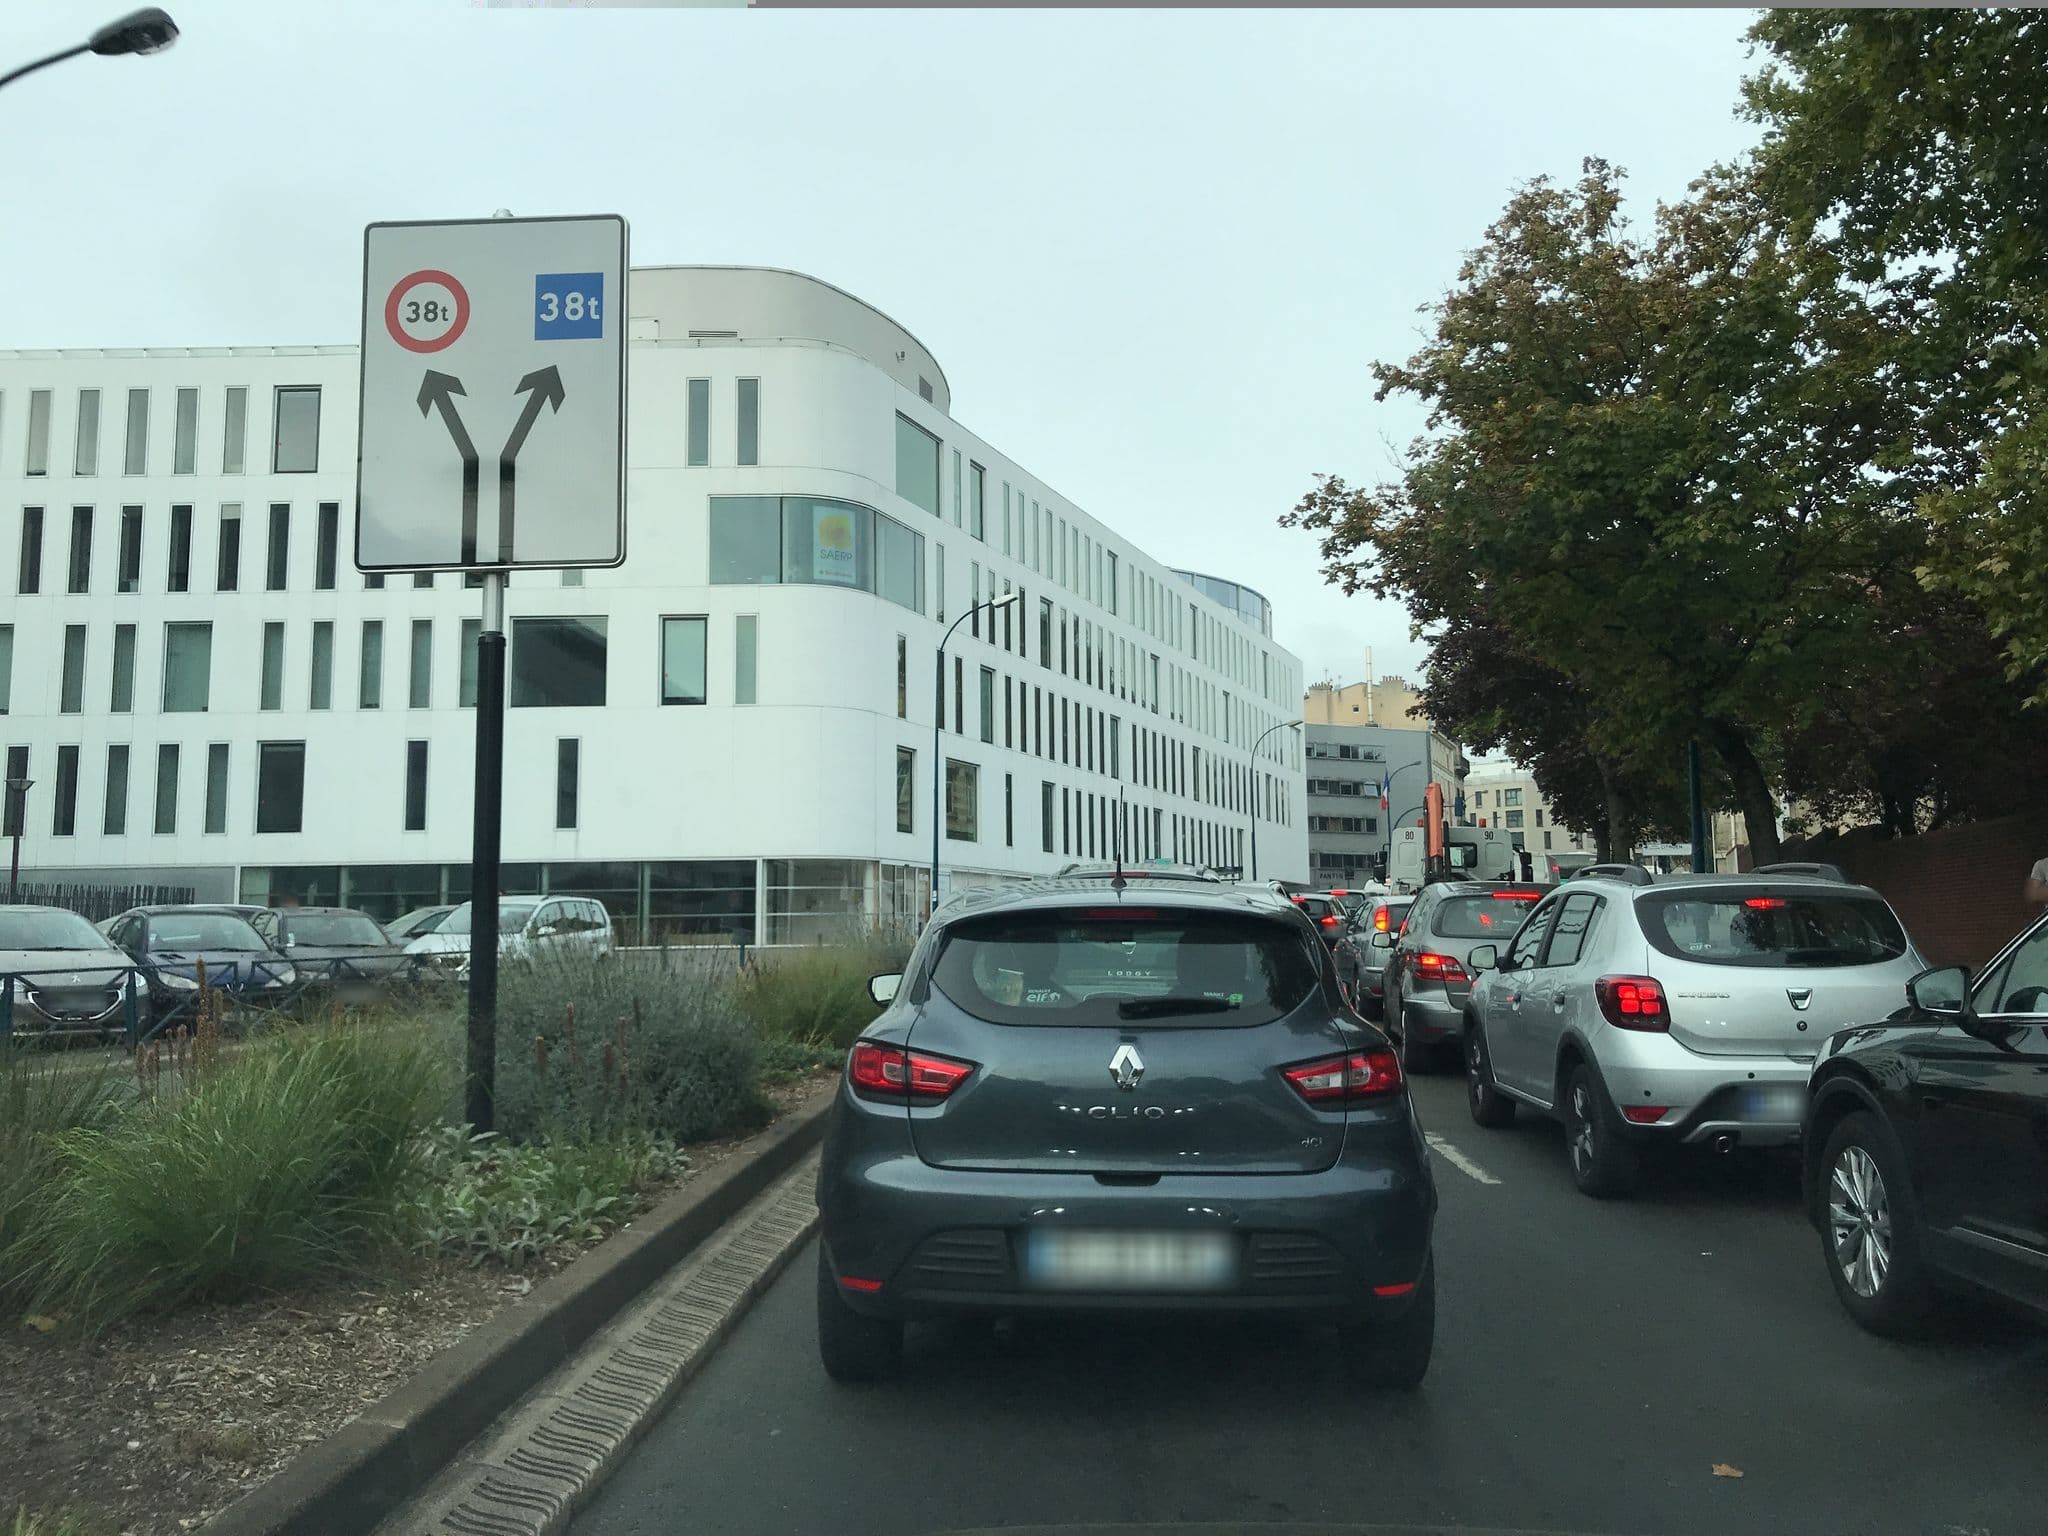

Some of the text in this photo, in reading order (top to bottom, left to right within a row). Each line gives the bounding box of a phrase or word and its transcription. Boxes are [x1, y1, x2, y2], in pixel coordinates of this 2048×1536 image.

[405, 300, 449, 323] 38t
[540, 291, 600, 322] 38t
[819, 548, 853, 561] SAERP
[1404, 830, 1415, 841] 80
[1484, 830, 1494, 841] 90
[1026, 993, 1049, 1002] elf
[1088, 1106, 1166, 1119] CLIO
